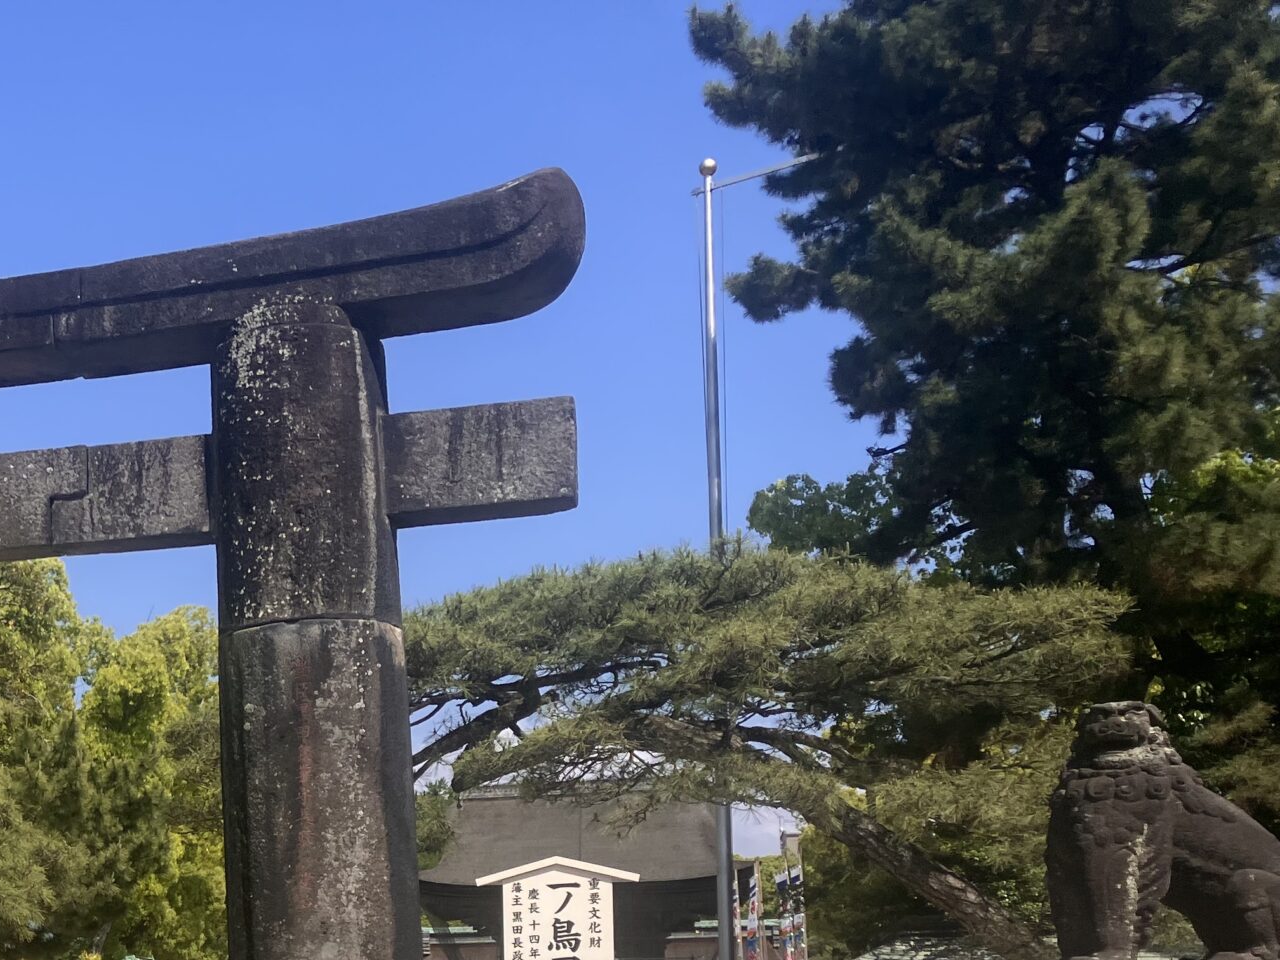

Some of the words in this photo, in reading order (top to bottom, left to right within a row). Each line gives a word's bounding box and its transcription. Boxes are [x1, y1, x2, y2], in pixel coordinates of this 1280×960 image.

[587, 877, 603, 949] 重要文化財
